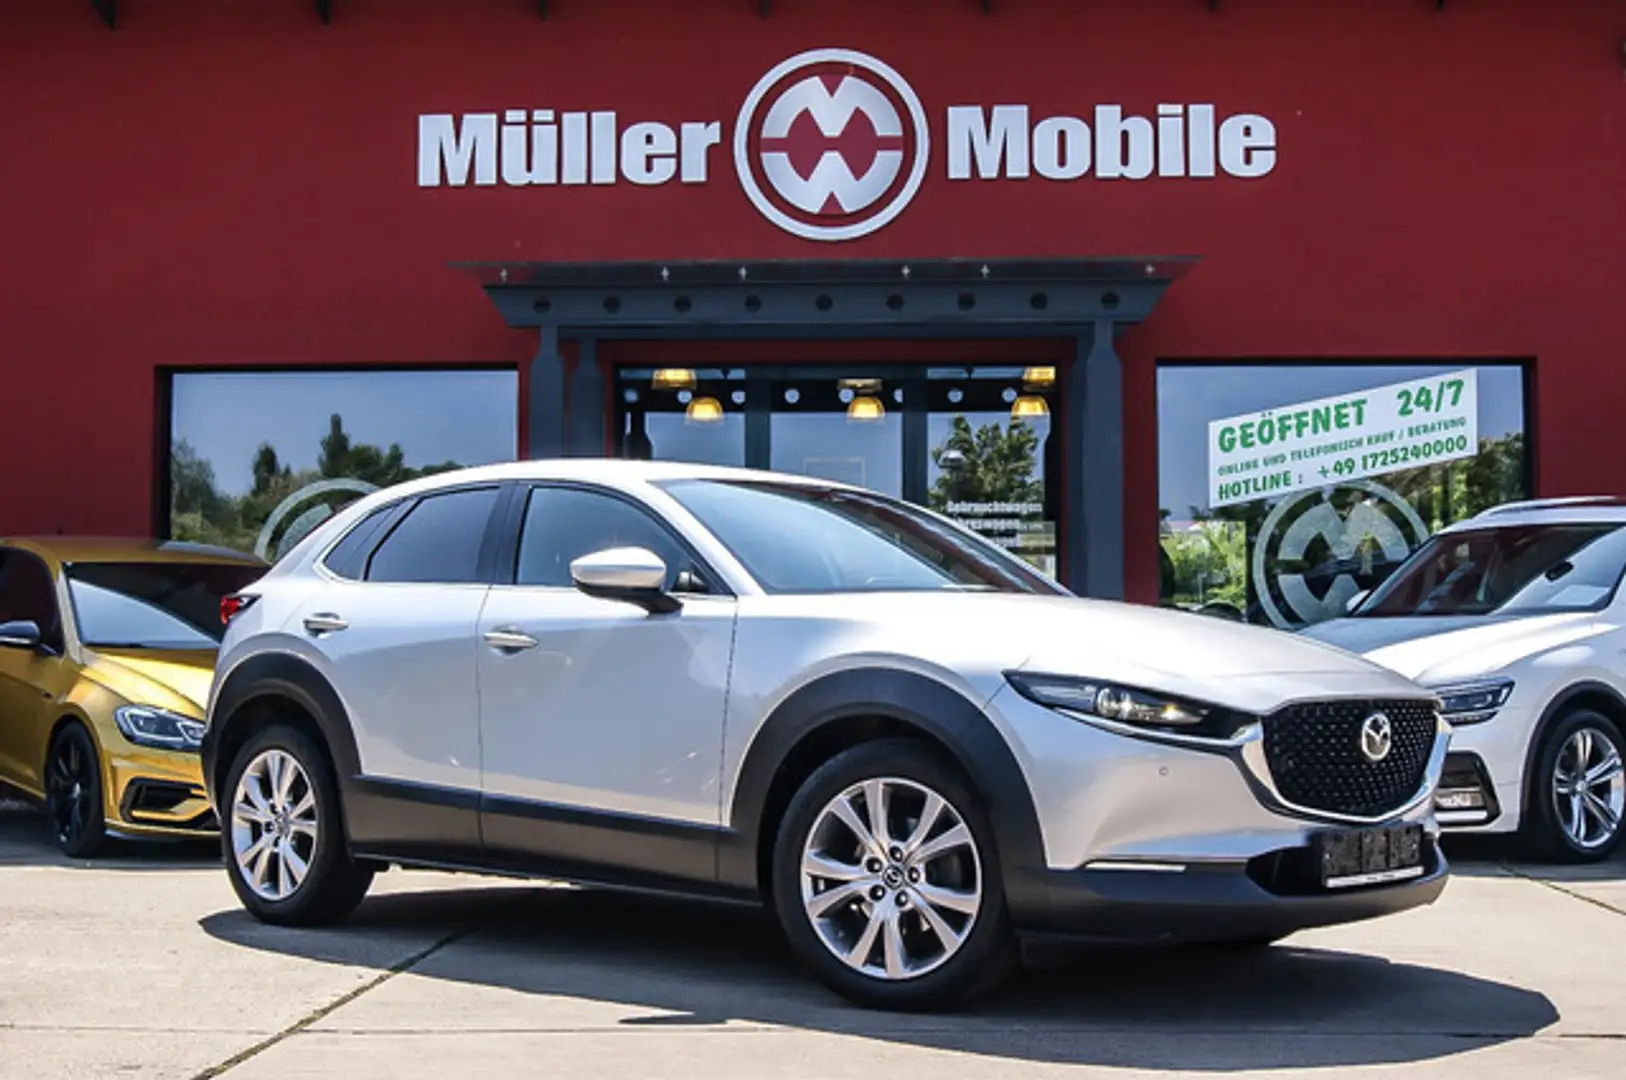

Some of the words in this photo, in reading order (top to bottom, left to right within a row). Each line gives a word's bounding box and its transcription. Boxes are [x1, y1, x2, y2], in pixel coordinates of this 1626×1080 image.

[418, 109, 721, 187] Müller
[947, 103, 1277, 180] Mobile
[1217, 458, 1259, 477] ONLINE
[1262, 453, 1287, 467] UND
[1290, 437, 1363, 462] TELEFONISCH
[1407, 416, 1468, 438] BERATUNG
[1218, 398, 1368, 453] GEÖFFNET
[1397, 379, 1465, 416] 24/7
[1217, 470, 1292, 500] HOTLINE
[1362, 434, 1468, 471] 1725240000
